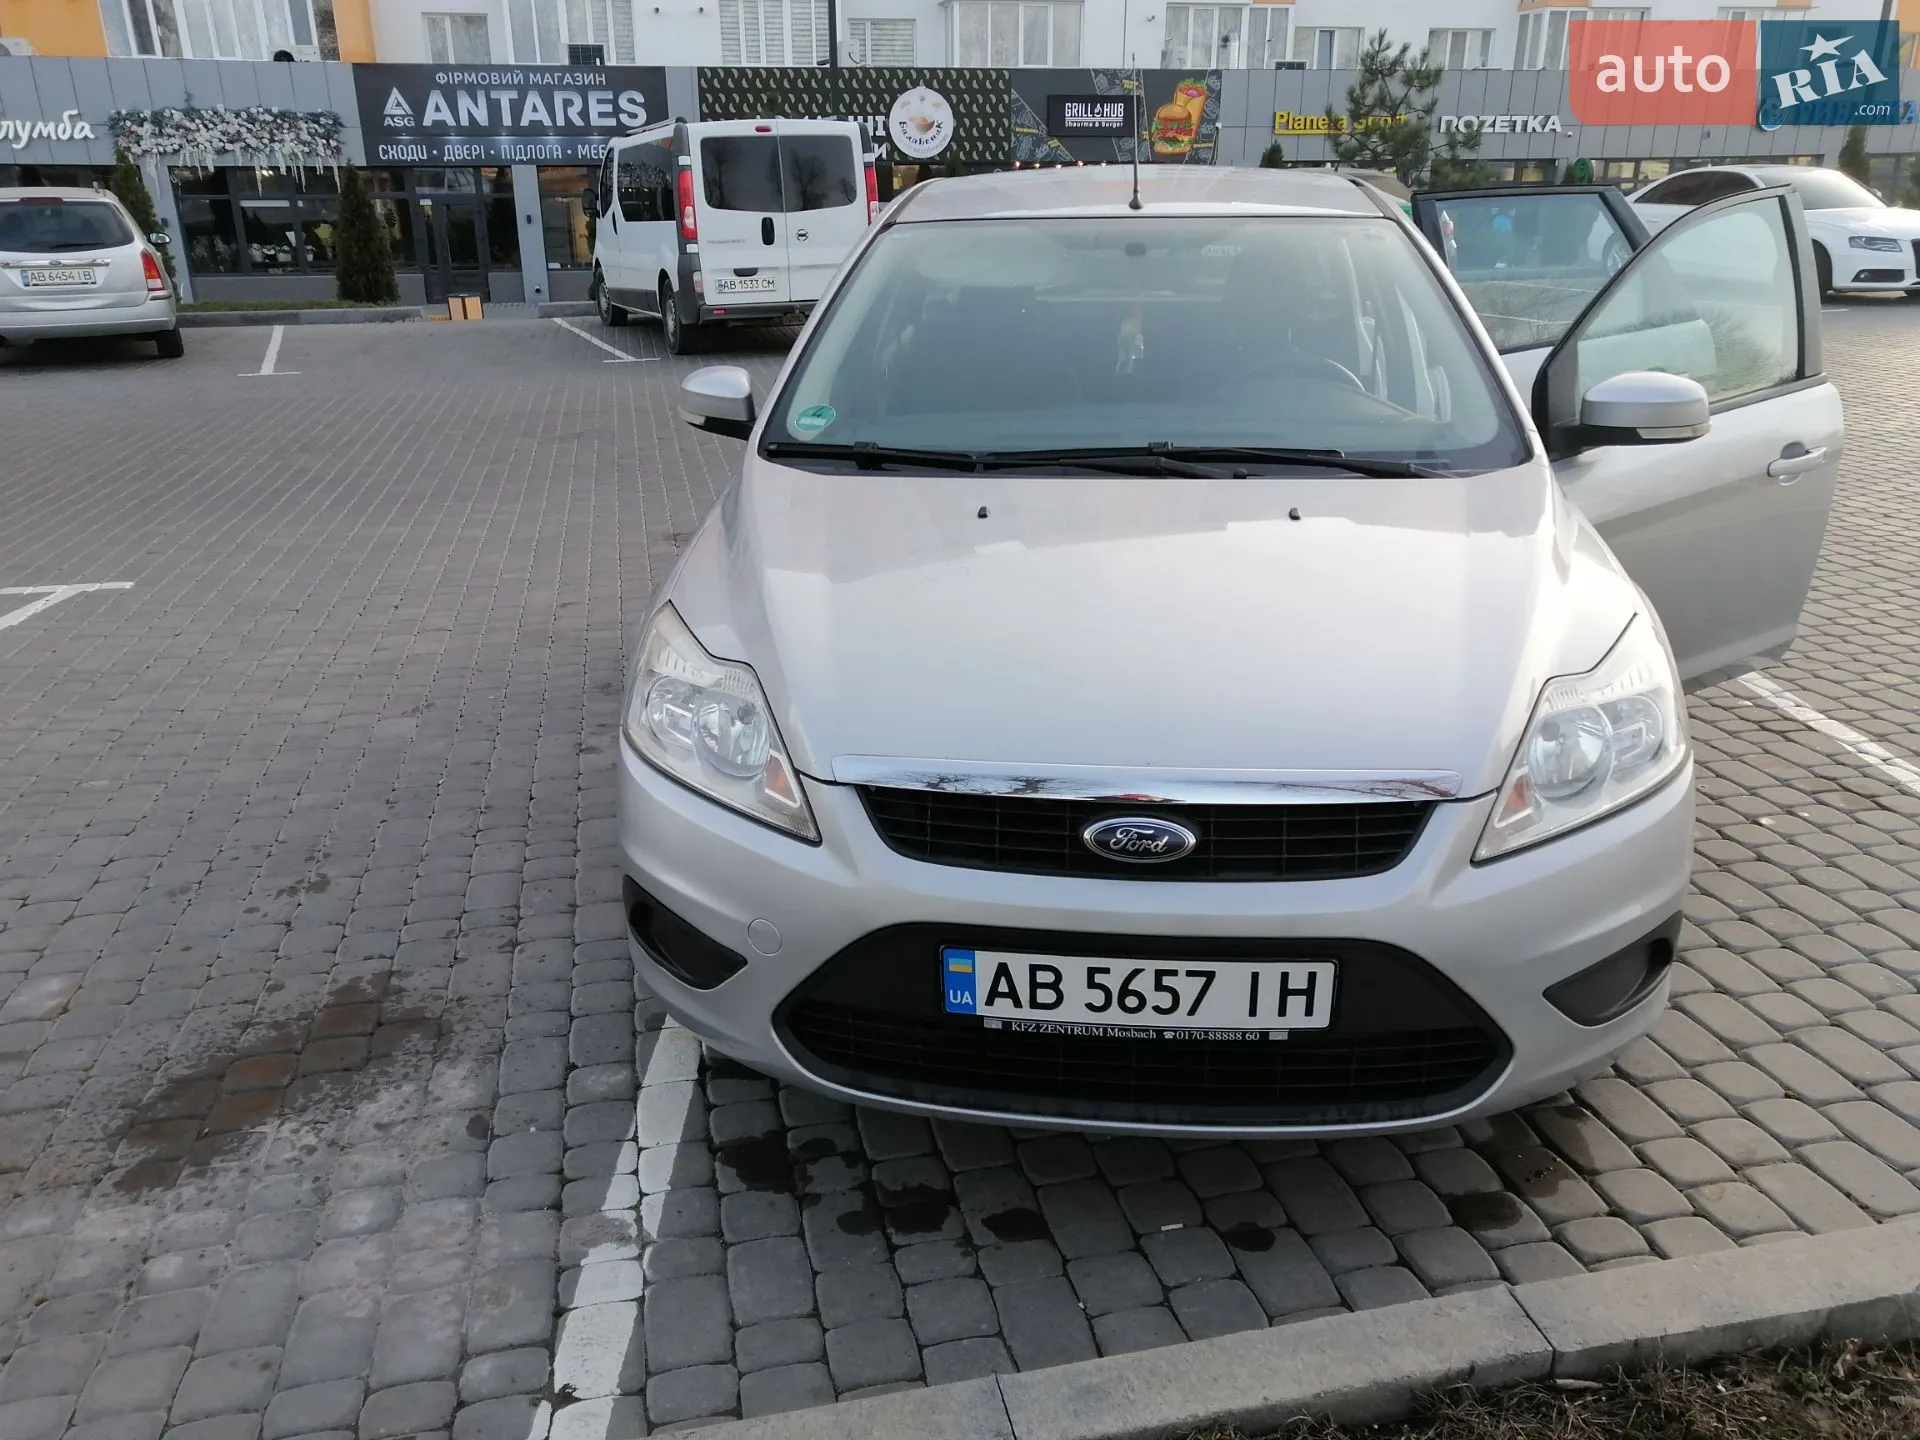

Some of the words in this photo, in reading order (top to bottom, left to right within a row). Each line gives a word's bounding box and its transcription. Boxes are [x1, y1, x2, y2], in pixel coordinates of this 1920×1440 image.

[435, 70, 524, 85] ФІРМОВИЙ
[529, 72, 607, 86] МАГАЗИН
[422, 89, 648, 128] ANTARES
[1065, 102, 1093, 117] GRILL
[1103, 102, 1125, 117] HUB
[383, 116, 416, 127] ASG
[1101, 121, 1124, 129] Burger
[1274, 111, 1348, 131] Planea
[1439, 115, 1562, 134] ROZETKA
[500, 144, 562, 162] ПІДЛОГА
[30, 272, 46, 282] AB
[48, 271, 75, 281] 6454
[723, 281, 737, 290] AB
[739, 280, 759, 289] 1533
[761, 280, 775, 288] CM
[1110, 827, 1169, 853] Ford
[949, 989, 973, 1005] UA
[984, 961, 1064, 1011] AB
[1084, 966, 1216, 1017] 5657
[1248, 971, 1318, 1018] IH
[1011, 1021, 1037, 1033] KFZ
[1039, 1022, 1104, 1037] ZENTRUM
[1107, 1027, 1157, 1039] Mosbach
[1176, 1030, 1243, 1041] 0170-88888
[1245, 1031, 1260, 1041] 60
